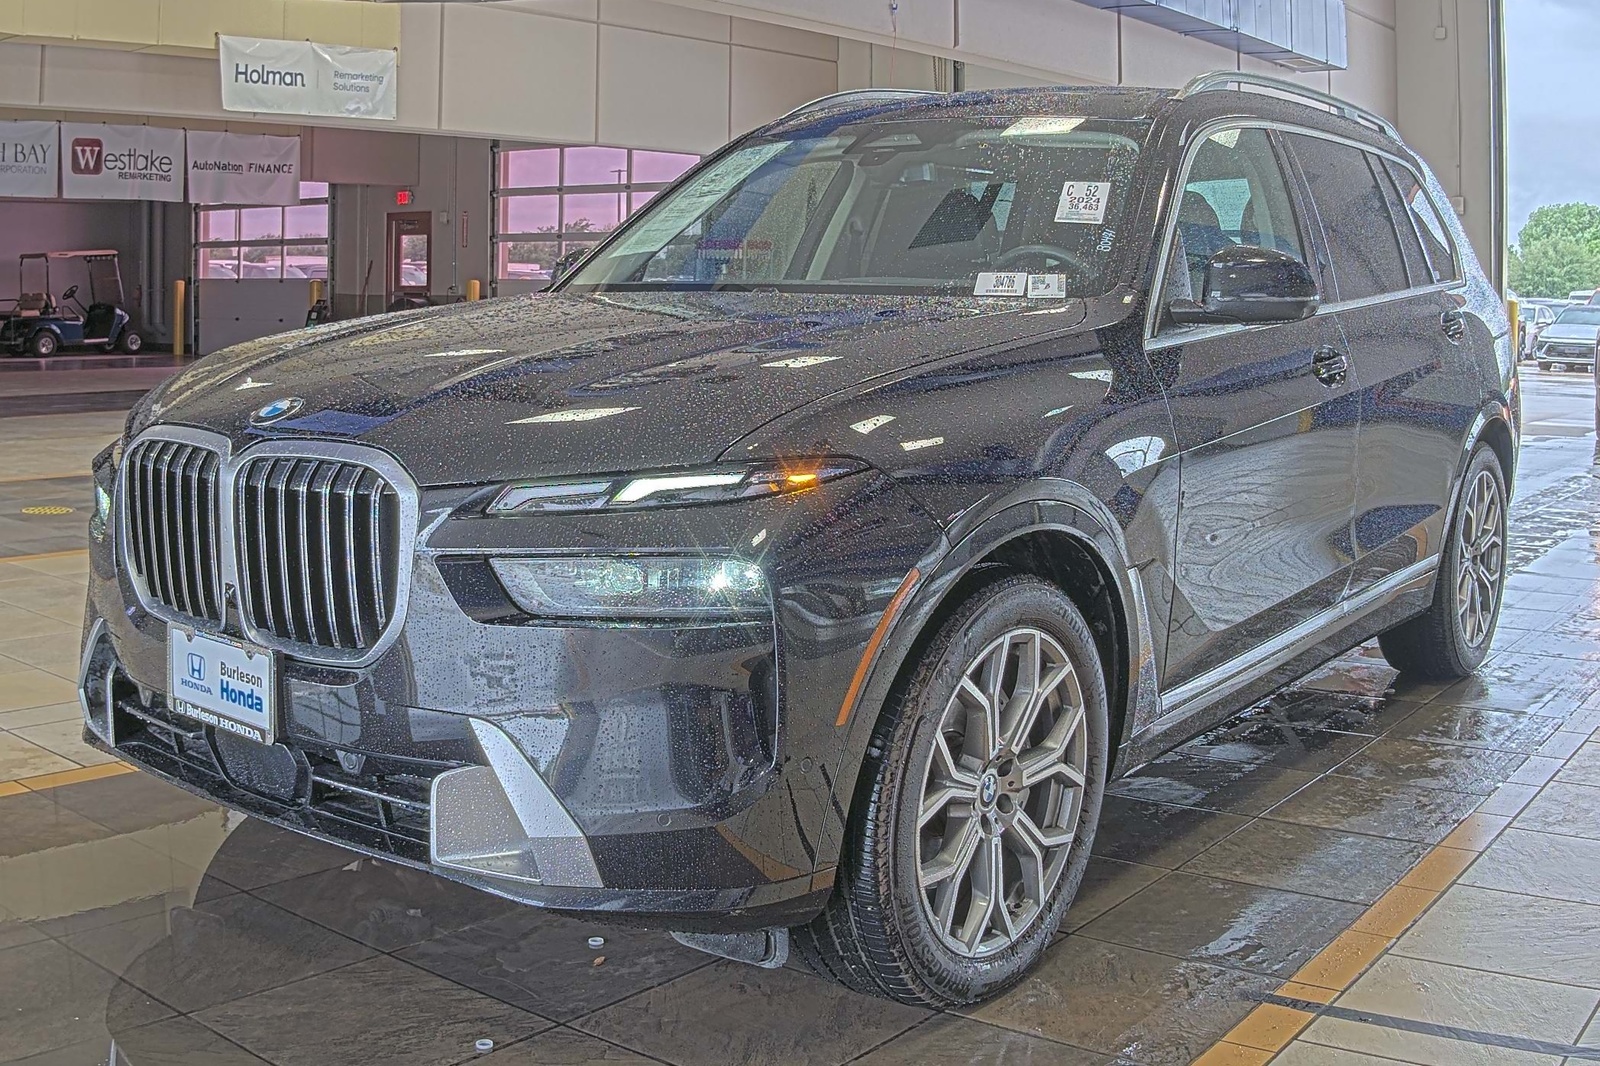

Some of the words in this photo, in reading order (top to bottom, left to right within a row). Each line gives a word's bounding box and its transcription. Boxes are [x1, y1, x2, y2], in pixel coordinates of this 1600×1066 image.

[234, 63, 306, 88] Holman
[334, 70, 385, 85] Remarketing
[333, 82, 370, 93] Solutions
[14, 142, 51, 164] BAY
[74, 146, 173, 173] Westlake
[192, 160, 244, 173] AutoNation
[248, 163, 294, 174] FINANCE
[118, 172, 172, 182] REMARKETING
[1067, 184, 1075, 197] C
[1085, 185, 1099, 197] 52
[1068, 196, 1101, 204] 2024
[220, 660, 263, 689] Burleson
[180, 677, 213, 696] HONDA
[220, 678, 264, 713] Honda
[186, 703, 219, 726] Burleson
[219, 717, 263, 742] HONDA
